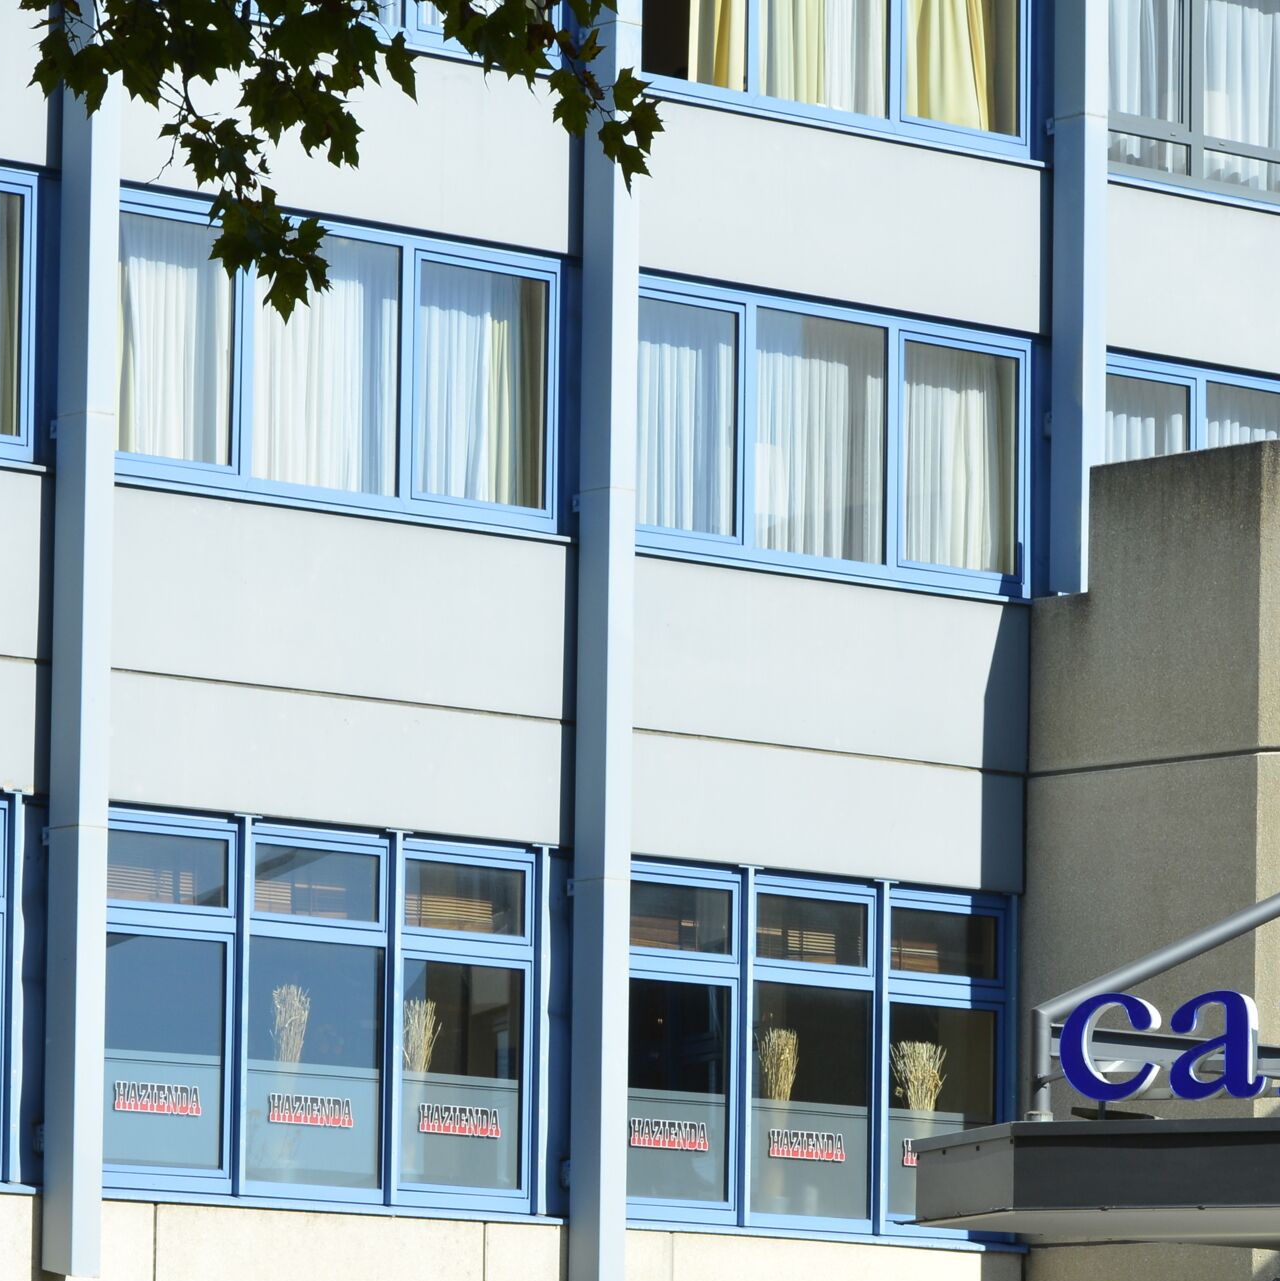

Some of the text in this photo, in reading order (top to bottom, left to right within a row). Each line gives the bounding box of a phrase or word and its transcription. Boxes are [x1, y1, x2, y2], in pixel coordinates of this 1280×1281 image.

[114, 1081, 202, 1116] HAZIENDA
[269, 1093, 354, 1128] HAZIENDA
[419, 1103, 501, 1138] HAZIENDA
[630, 1118, 708, 1151] HAZIENDA
[769, 1128, 846, 1162] HAZIENDA
